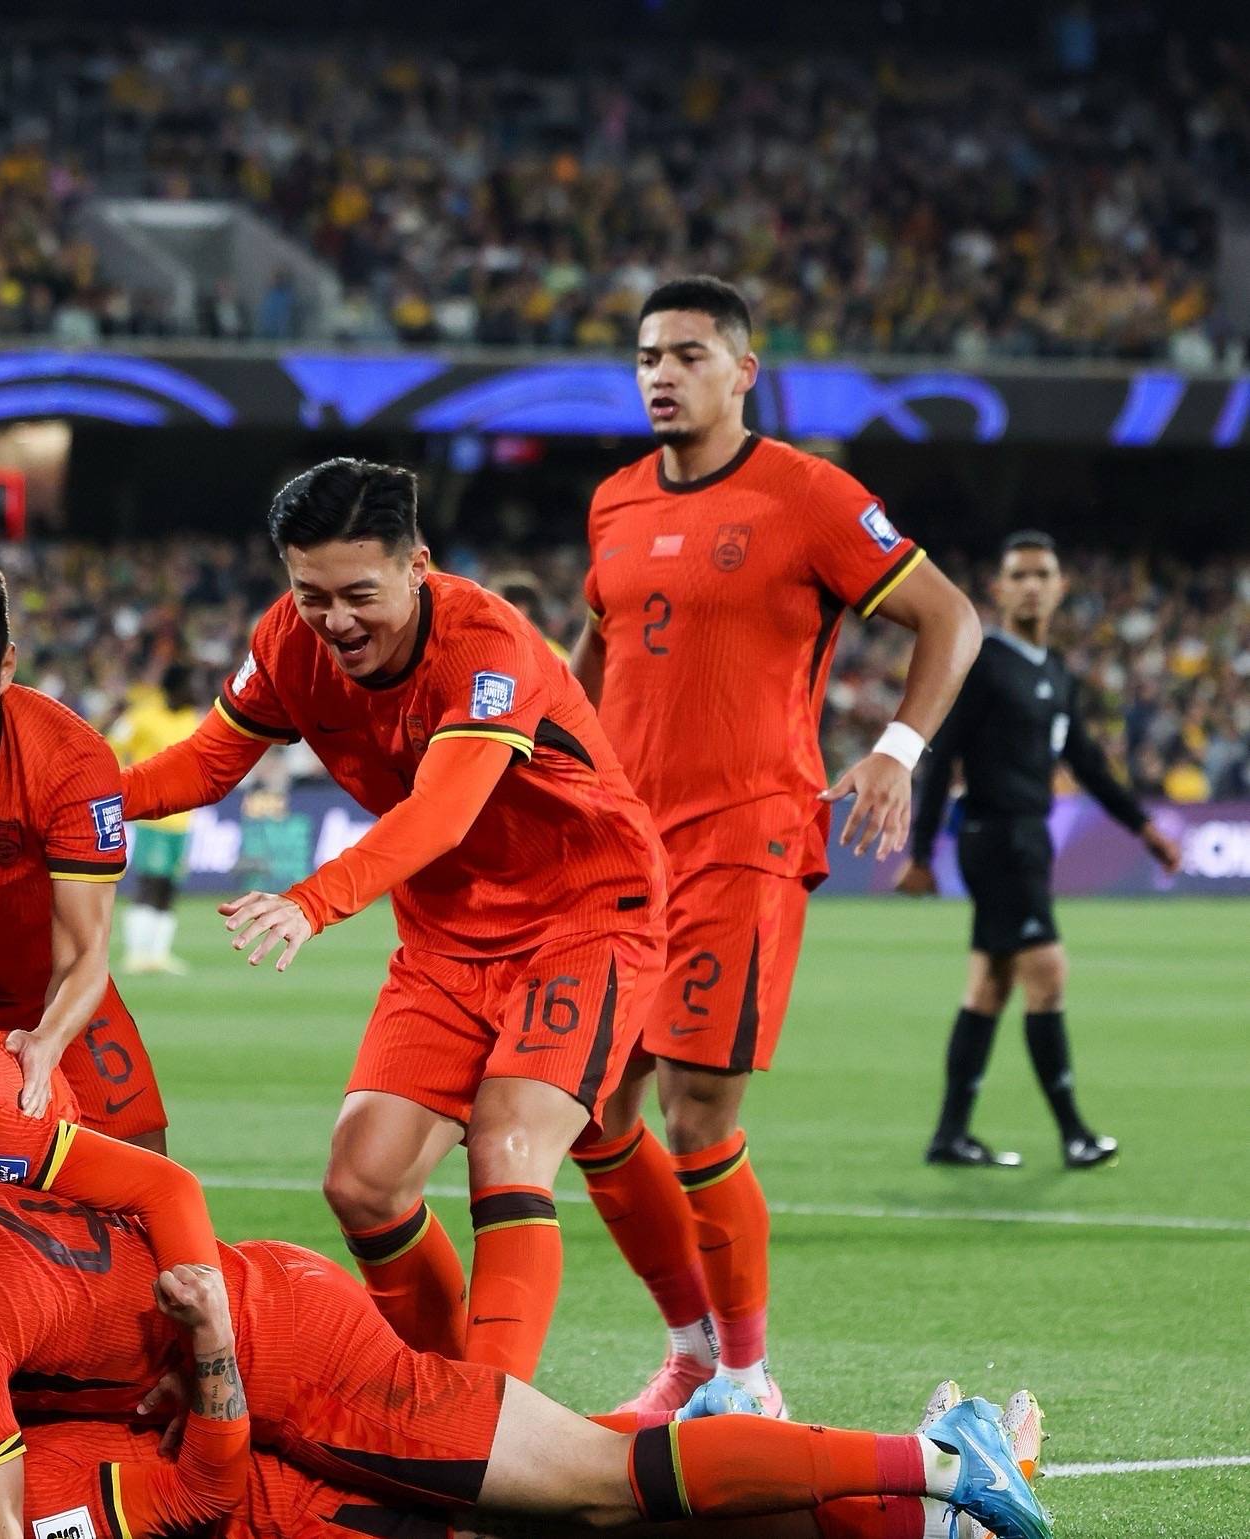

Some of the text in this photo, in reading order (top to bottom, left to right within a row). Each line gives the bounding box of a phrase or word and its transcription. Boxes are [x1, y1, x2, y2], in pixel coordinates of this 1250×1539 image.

[644, 592, 672, 656] 2
[522, 975, 581, 1035] 16
[683, 951, 722, 1017] 2
[84, 1018, 133, 1085] 6
